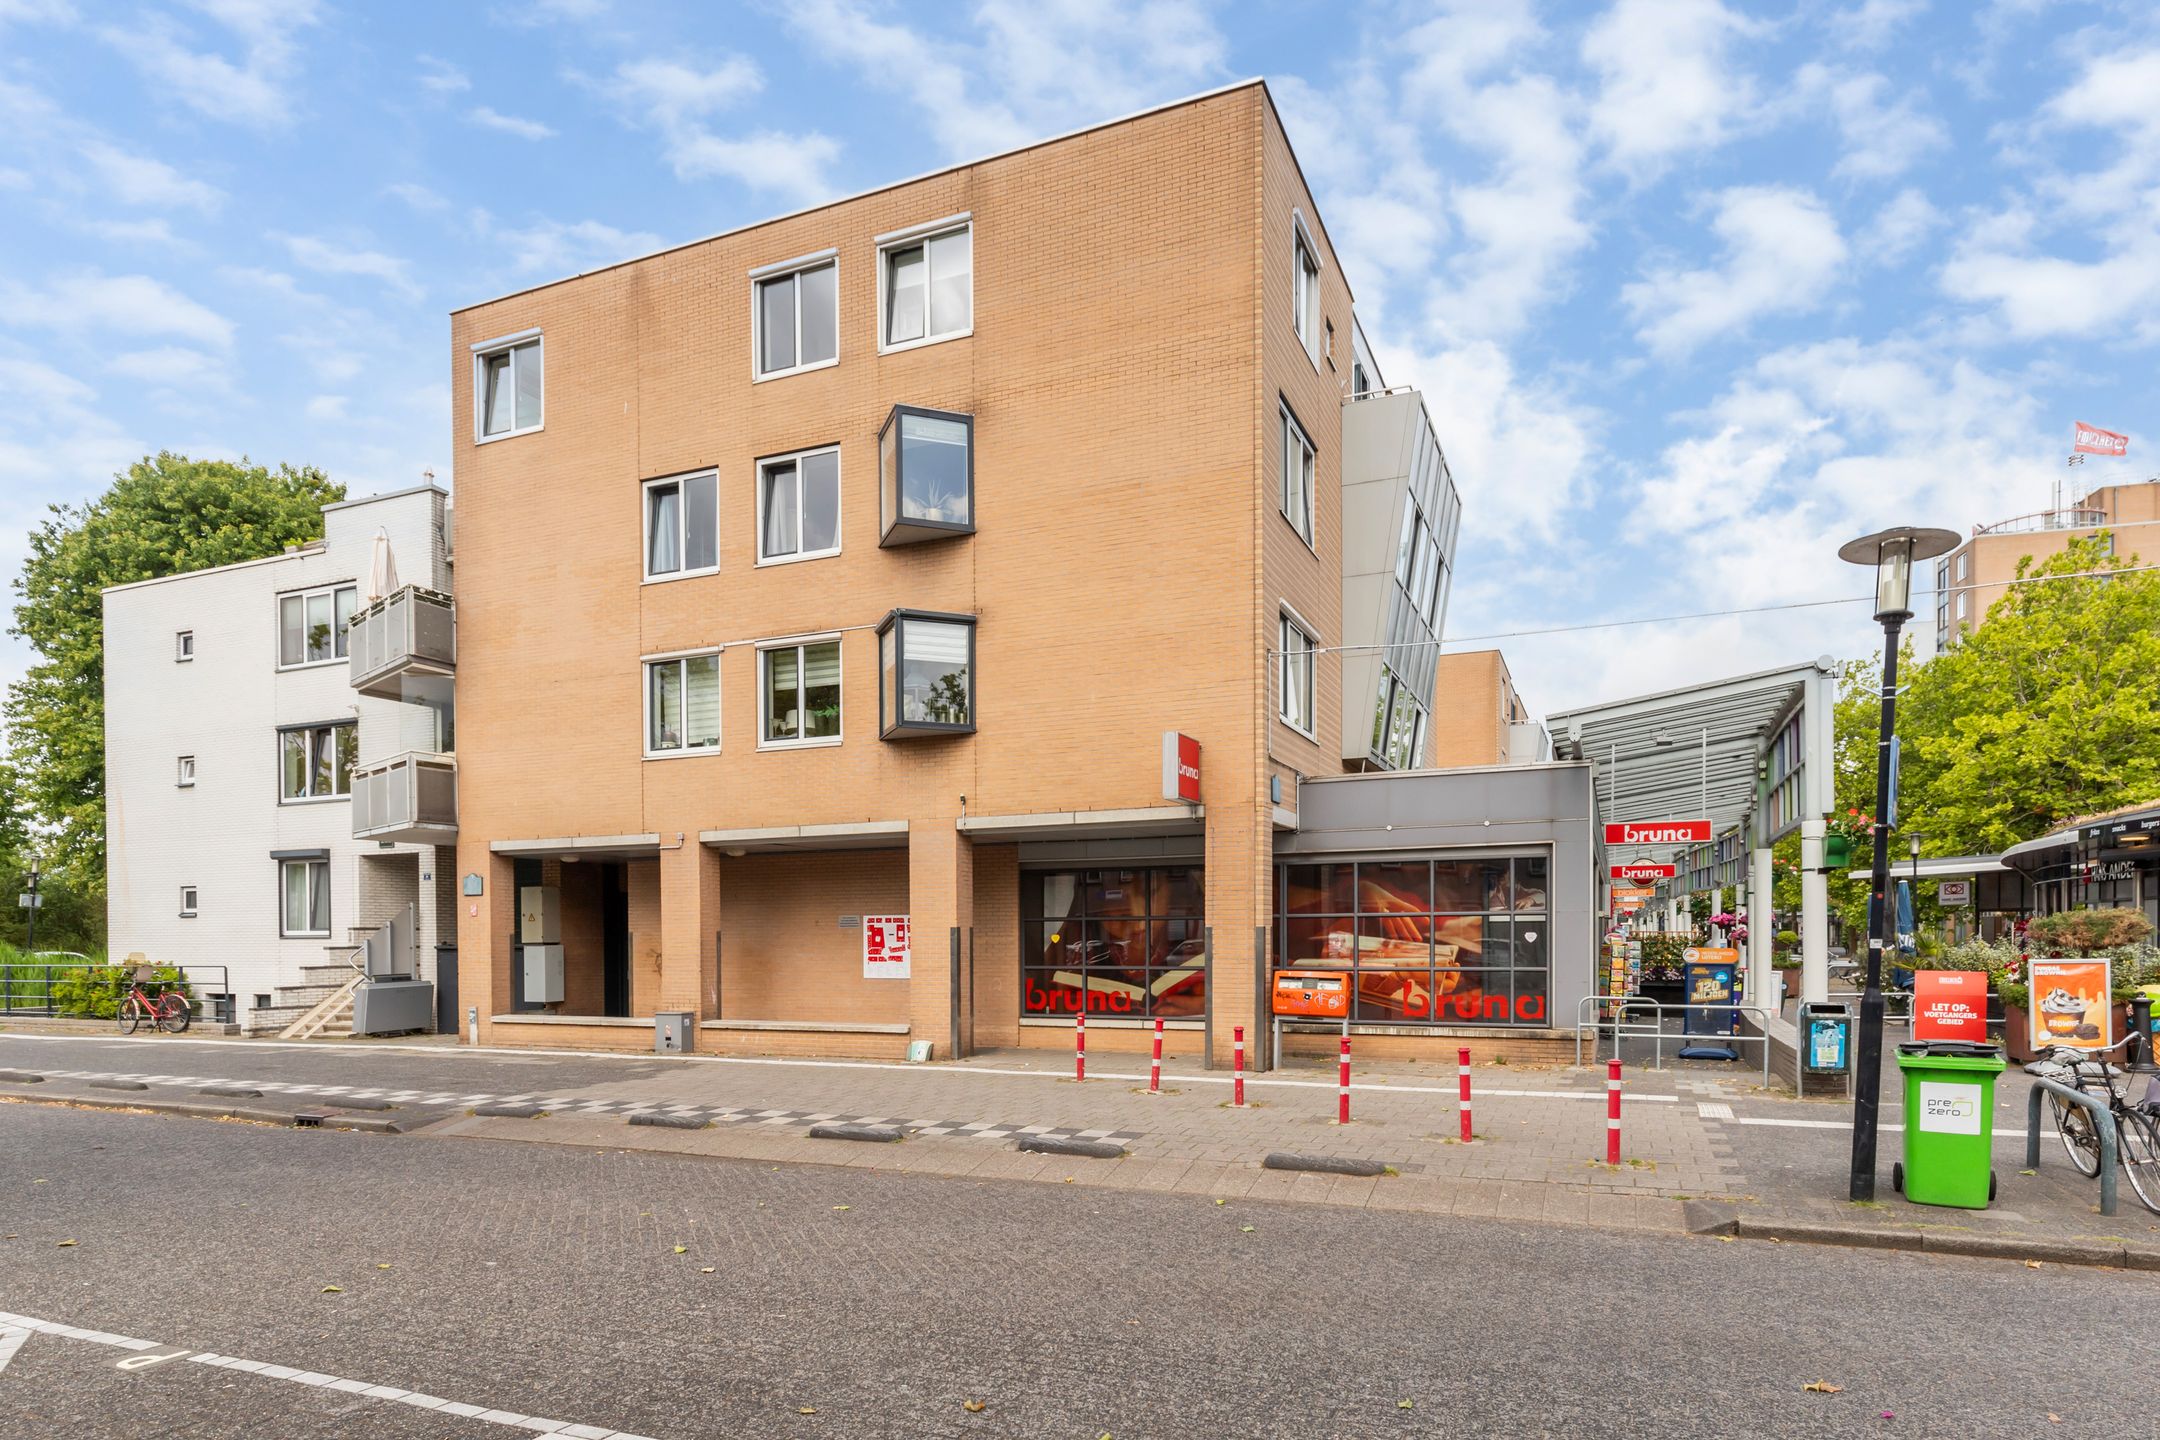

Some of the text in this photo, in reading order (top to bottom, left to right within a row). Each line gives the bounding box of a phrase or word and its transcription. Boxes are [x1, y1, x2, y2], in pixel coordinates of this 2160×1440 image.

[1178, 757, 1199, 780] bruna
[1624, 824, 1692, 843] bruna
[1622, 866, 1664, 878] bruna
[1025, 978, 1131, 1012] bruna
[1403, 979, 1545, 1020] bruna
[1931, 1003, 1970, 1013] LET OP:
[1923, 1011, 1978, 1019] VOETGANGERS
[1937, 1018, 1964, 1026] GEBIED
[1927, 1099, 1952, 1108] pre
[1928, 1107, 1961, 1117] zero
